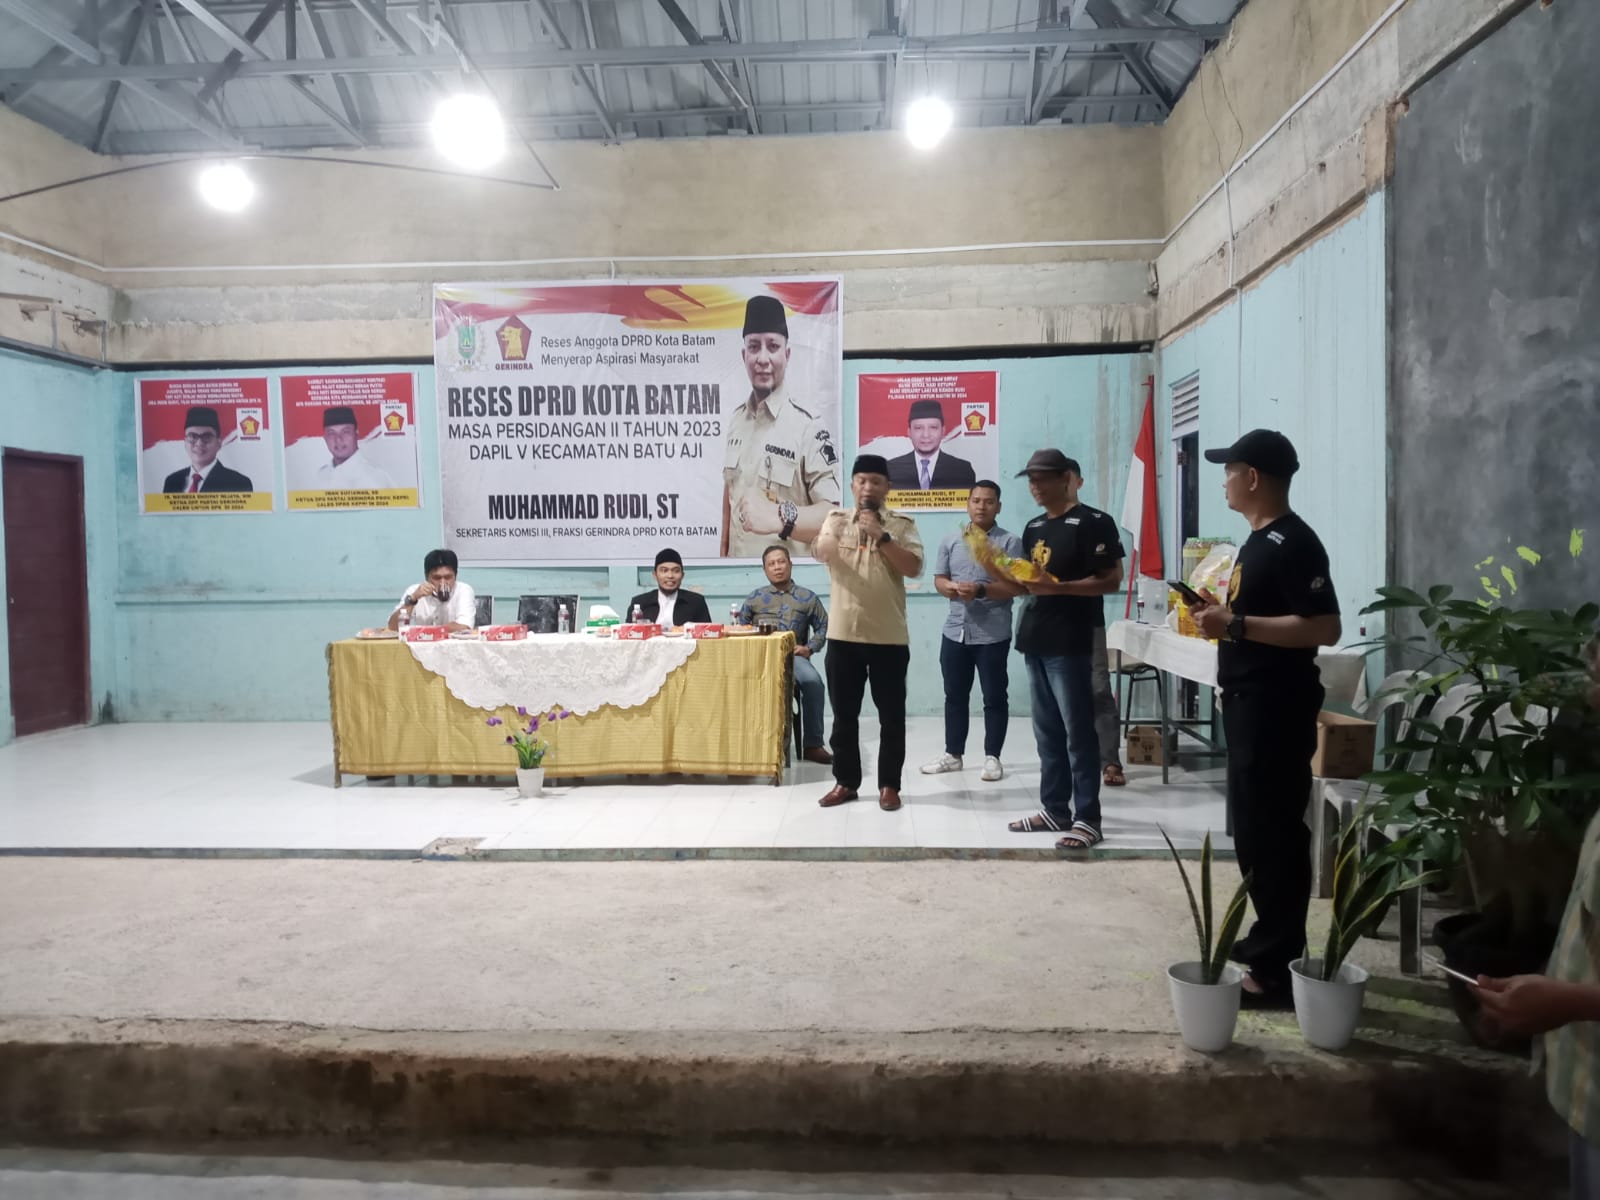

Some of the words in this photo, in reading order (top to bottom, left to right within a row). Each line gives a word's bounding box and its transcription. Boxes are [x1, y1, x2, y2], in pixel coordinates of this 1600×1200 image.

[541, 336, 572, 348] Reses
[574, 335, 619, 350] Anggota
[621, 334, 653, 347] DPRD
[655, 334, 680, 347] Kota
[682, 334, 716, 346] Batam
[495, 362, 534, 371] GERINDRA
[541, 352, 593, 367] Menyerap
[595, 352, 637, 367] Aspirasi
[640, 351, 700, 366] Masyarakat
[448, 385, 513, 417] RESES
[518, 385, 577, 416] DPRD
[582, 384, 640, 416] KOTA
[645, 383, 721, 415] BATAM
[448, 422, 492, 439] MASA
[496, 421, 606, 439] PERSIDANGAN
[611, 422, 619, 437] II
[623, 421, 679, 437] TAHUN
[683, 421, 721, 437] 2023
[470, 444, 513, 460] DAPIL
[517, 444, 527, 460] V
[532, 443, 629, 460] KECAMATAN
[634, 443, 675, 459] BATU
[680, 442, 703, 459] AJI
[765, 443, 796, 460] GERINDRA
[488, 494, 599, 520] MUHAMMAD
[604, 493, 653, 522] RUDI,
[656, 493, 680, 519] ST
[456, 528, 507, 538] SEKRETARIS
[509, 527, 539, 537] KOMISI
[541, 528, 552, 538] III,
[553, 527, 583, 537] FRAKSI
[585, 527, 631, 537] GERINDRA
[633, 526, 658, 537] DPRD
[660, 526, 684, 537] KOTA
[686, 526, 718, 537] BATAM
